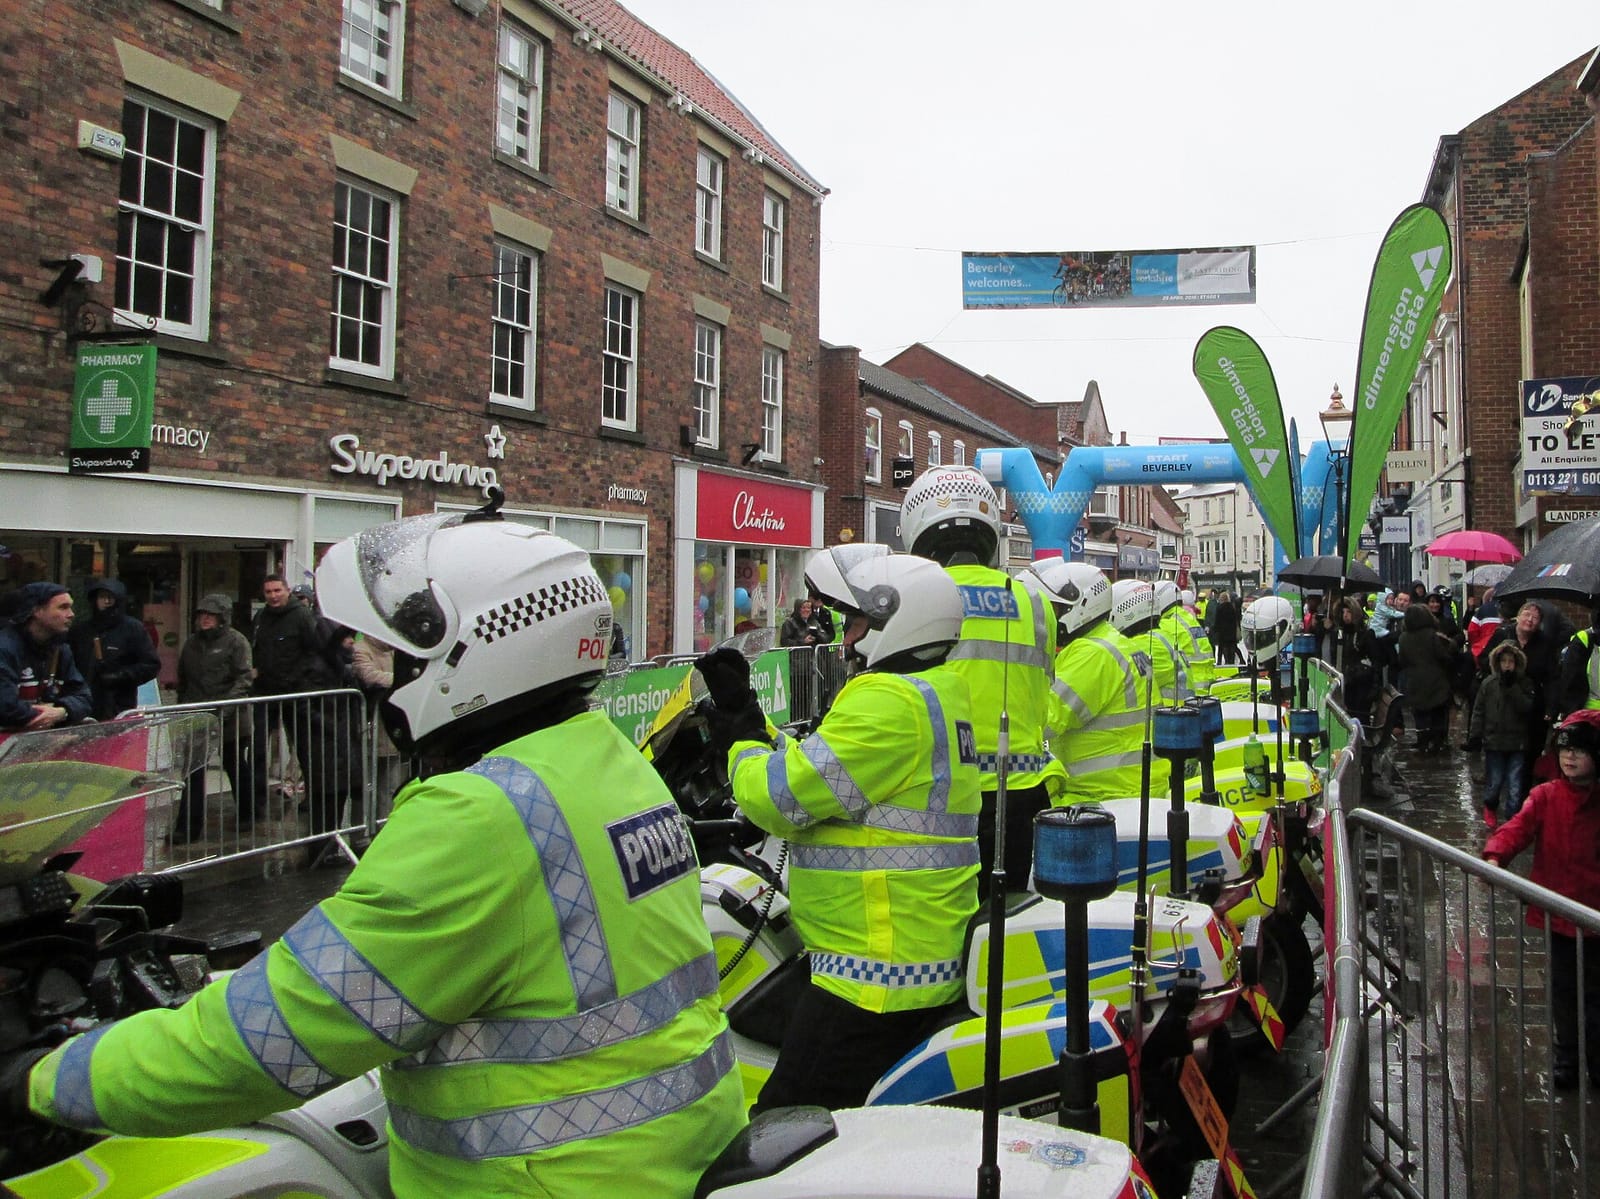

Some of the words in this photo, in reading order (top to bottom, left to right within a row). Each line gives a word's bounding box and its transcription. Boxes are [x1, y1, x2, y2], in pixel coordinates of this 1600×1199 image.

[967, 262, 1015, 274] Beverley
[967, 276, 1032, 288] welcomes...
[1400, 294, 1425, 350] data
[1365, 287, 1412, 410] dimension
[81, 354, 144, 366] PHARMACY
[1218, 357, 1268, 439] dimension
[1231, 408, 1255, 446] data
[1542, 420, 1565, 430] Sho
[150, 424, 210, 453] rmacy
[1528, 436, 1559, 452] TO
[72, 456, 135, 469] Superdrug
[1146, 454, 1189, 462] START
[1389, 460, 1427, 469] CELLINI
[1555, 456, 1597, 465] Enquiries
[330, 434, 501, 499] Superdrug
[1142, 463, 1193, 473] BEVERLEY
[894, 470, 913, 479] DP
[937, 473, 980, 484] POLICE
[1528, 473, 1555, 486] 0113
[1558, 472, 1578, 484] 221
[608, 484, 648, 504] pharmacy
[732, 490, 786, 532] Clintons
[962, 590, 1015, 613] LICE
[578, 638, 606, 660] POL
